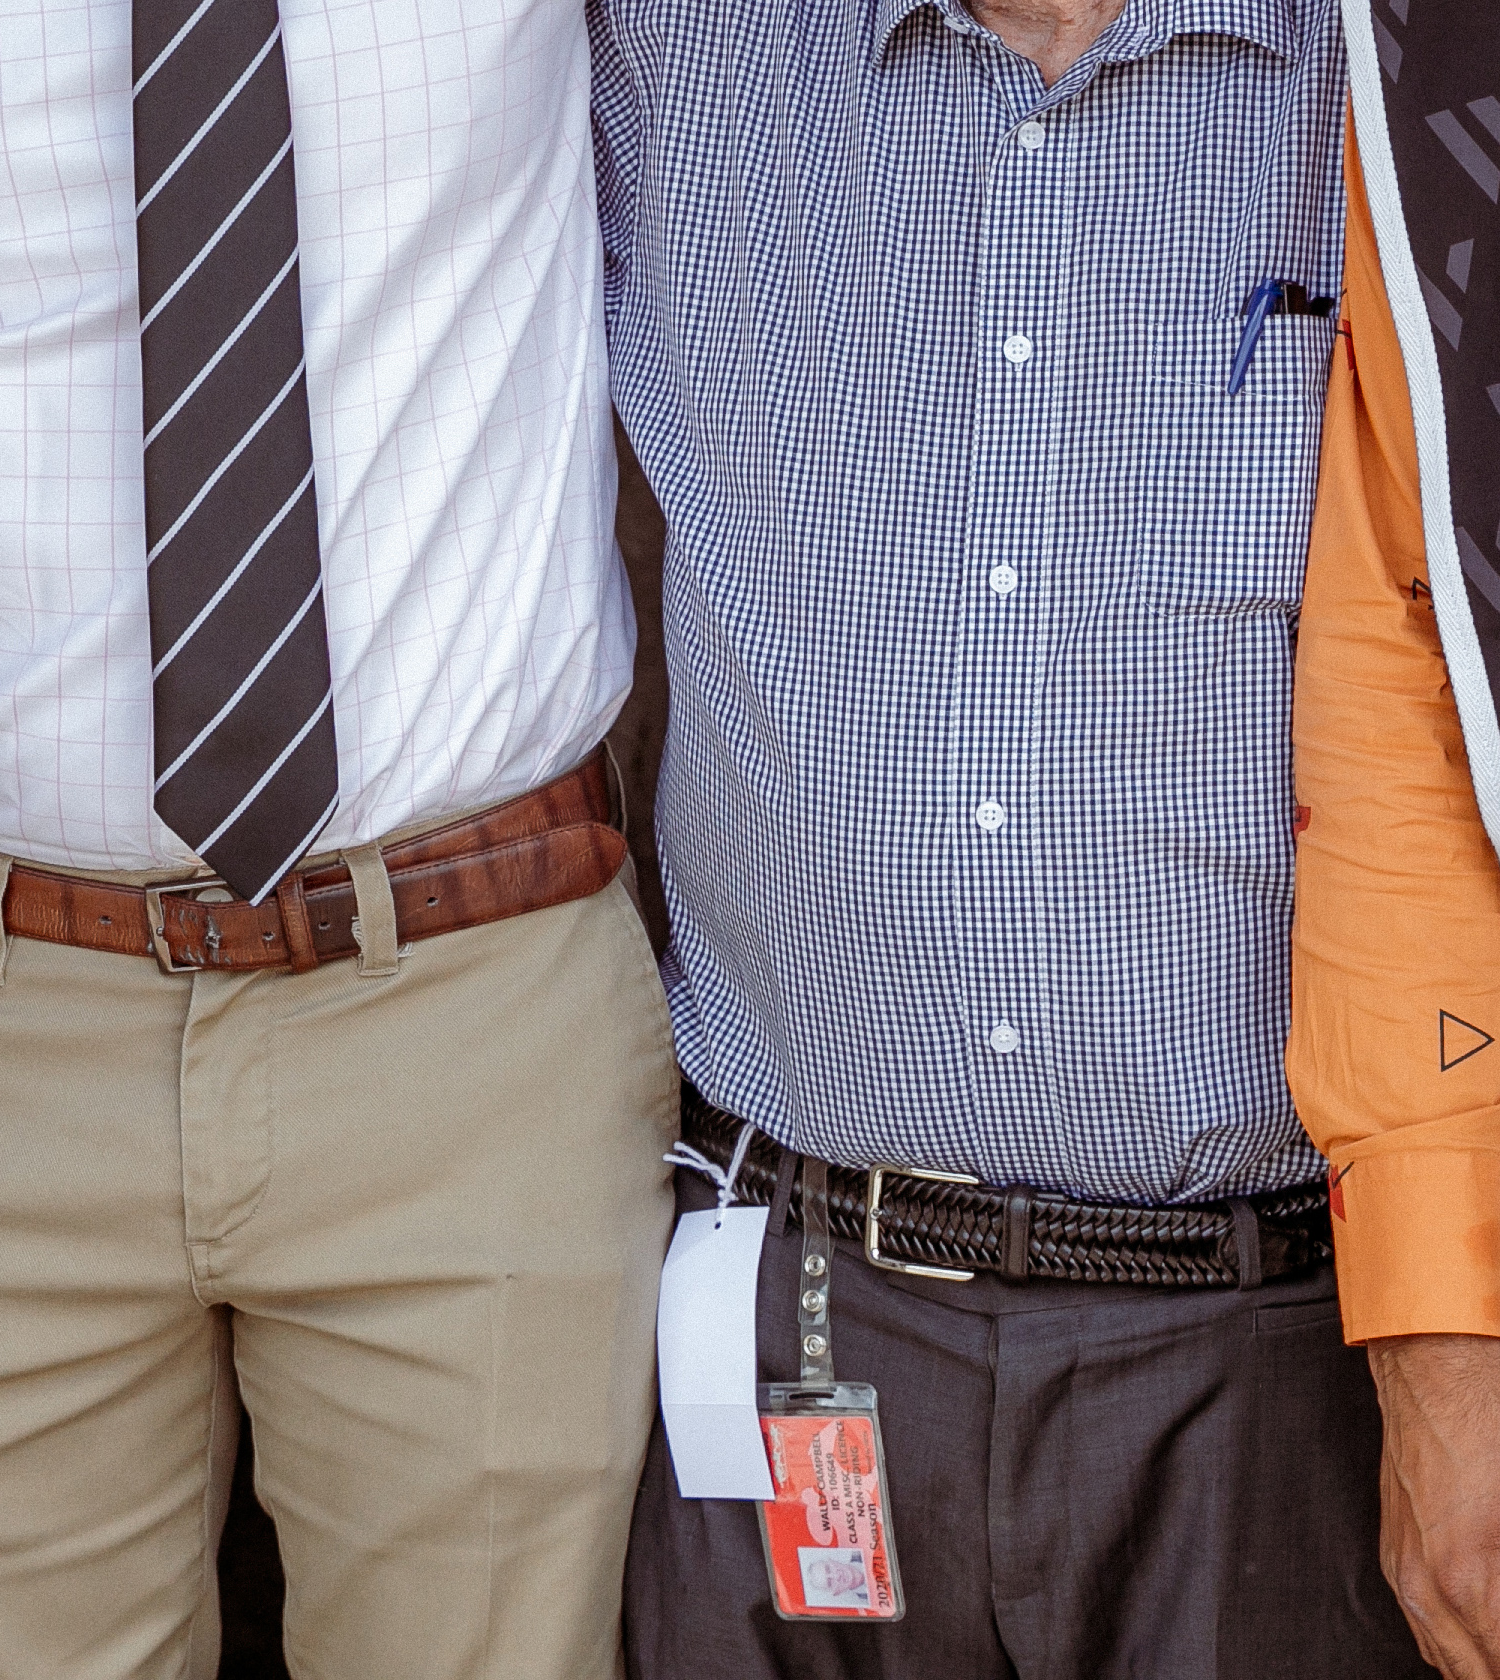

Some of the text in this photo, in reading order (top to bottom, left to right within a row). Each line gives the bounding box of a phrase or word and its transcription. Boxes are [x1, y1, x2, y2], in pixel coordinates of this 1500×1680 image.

[836, 1420, 849, 1465] LICENCE
[812, 1432, 832, 1533] WALLY CAMPBELL
[826, 1453, 840, 1511] ID: 106649
[846, 1501, 854, 1509] A
[850, 1446, 866, 1518] NON-RIDING
[845, 1511, 858, 1544] CLASS
[868, 1503, 890, 1608] 2020/21 Season
